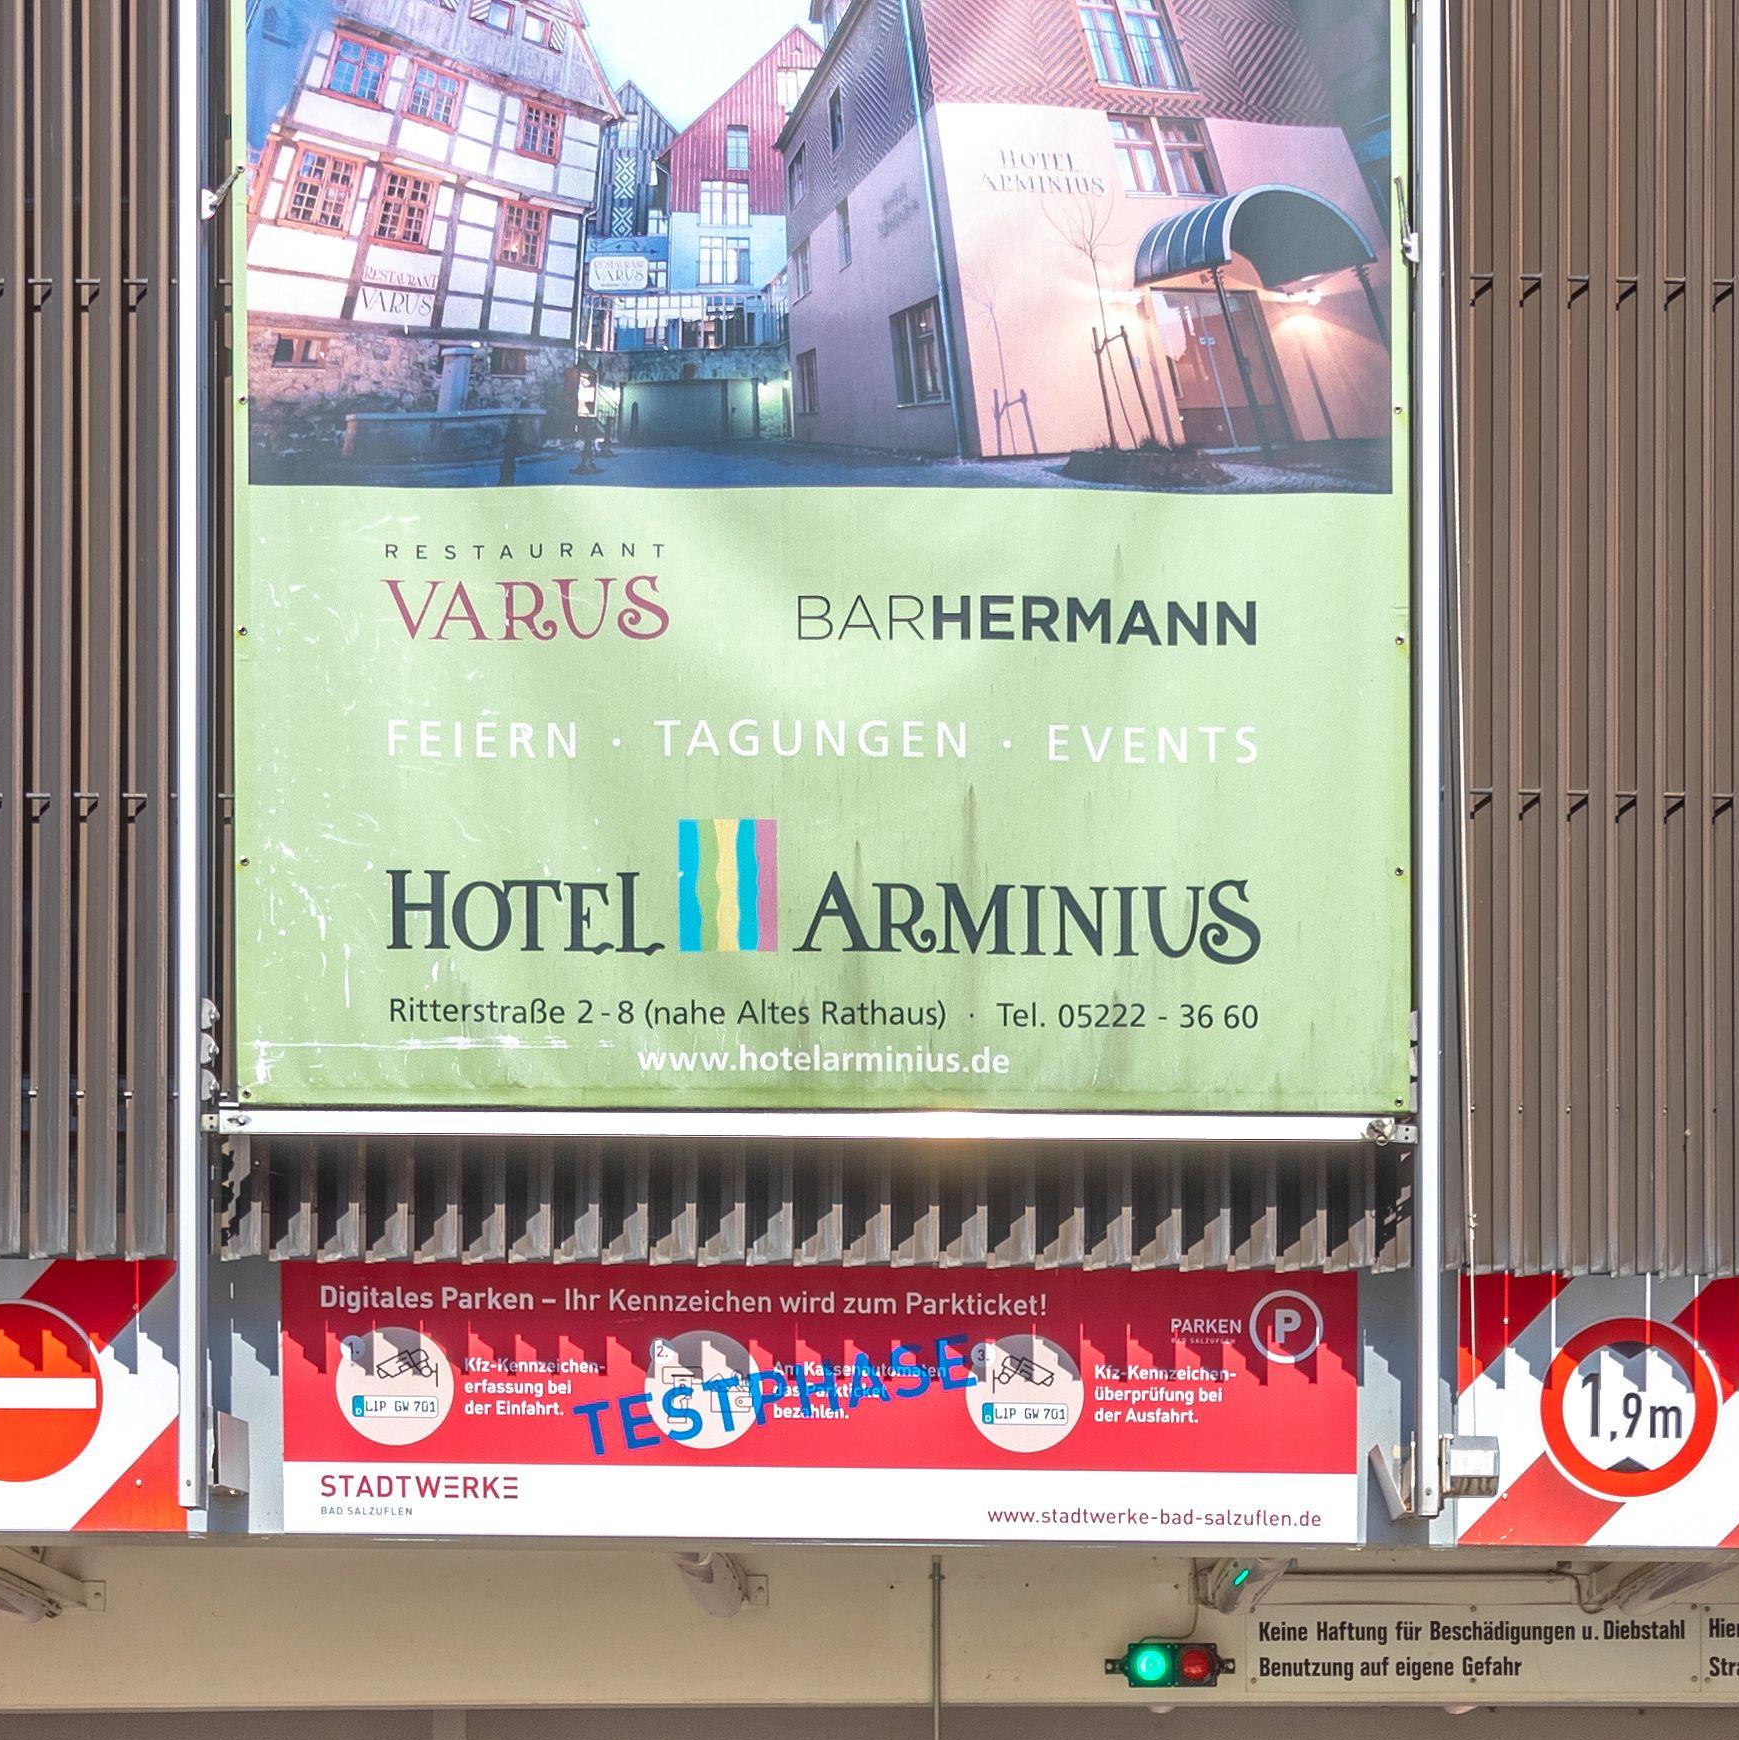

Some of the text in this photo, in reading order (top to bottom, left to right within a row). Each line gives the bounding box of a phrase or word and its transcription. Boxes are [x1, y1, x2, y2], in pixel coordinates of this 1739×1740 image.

[361, 287, 432, 317] VARUS
[385, 543, 665, 560] RESTAURANT
[380, 574, 670, 641] VARUS
[795, 594, 1259, 648] BARHERMANN
[387, 719, 1259, 766] FEIERN TAGUNGEN EVENTS
[386, 869, 1262, 966] HOTEL ARMINIUS
[390, 998, 1259, 1030] Ritterstraße 2 8 (nahe Altes Rathaus) Tel. 05222 36 60
[637, 1044, 1011, 1075] www.hotelarminius.de
[320, 1285, 1047, 1317] Digitales Parken Ihr Kennzeichen wird zum Parkticket!
[1171, 1318, 1242, 1334] PARKEN
[464, 1357, 605, 1375] Kfz-Kennzeichen-
[464, 1379, 572, 1398] erfassung bei
[572, 1333, 978, 1457] TESTPHASE
[1094, 1386, 1223, 1405] überprüfung bei
[365, 1400, 387, 1412] LIP
[464, 1400, 564, 1416] der Einfahrt.
[994, 1407, 1017, 1420] LIP
[1043, 1407, 1066, 1421] 701
[1094, 1408, 1199, 1424] der Ausfahrt.
[320, 1474, 518, 1500] STADTWERKE
[320, 1506, 413, 1516] BAD SALZUFLEN
[987, 1507, 1322, 1528] www.stadtwerke-bad-salzuflen.de
[1259, 1619, 1685, 1645] Keine Haftung für Beschädigungen u. Diebstahl
[1259, 1657, 1522, 1680] Benutzung auf eigene Gefahr
